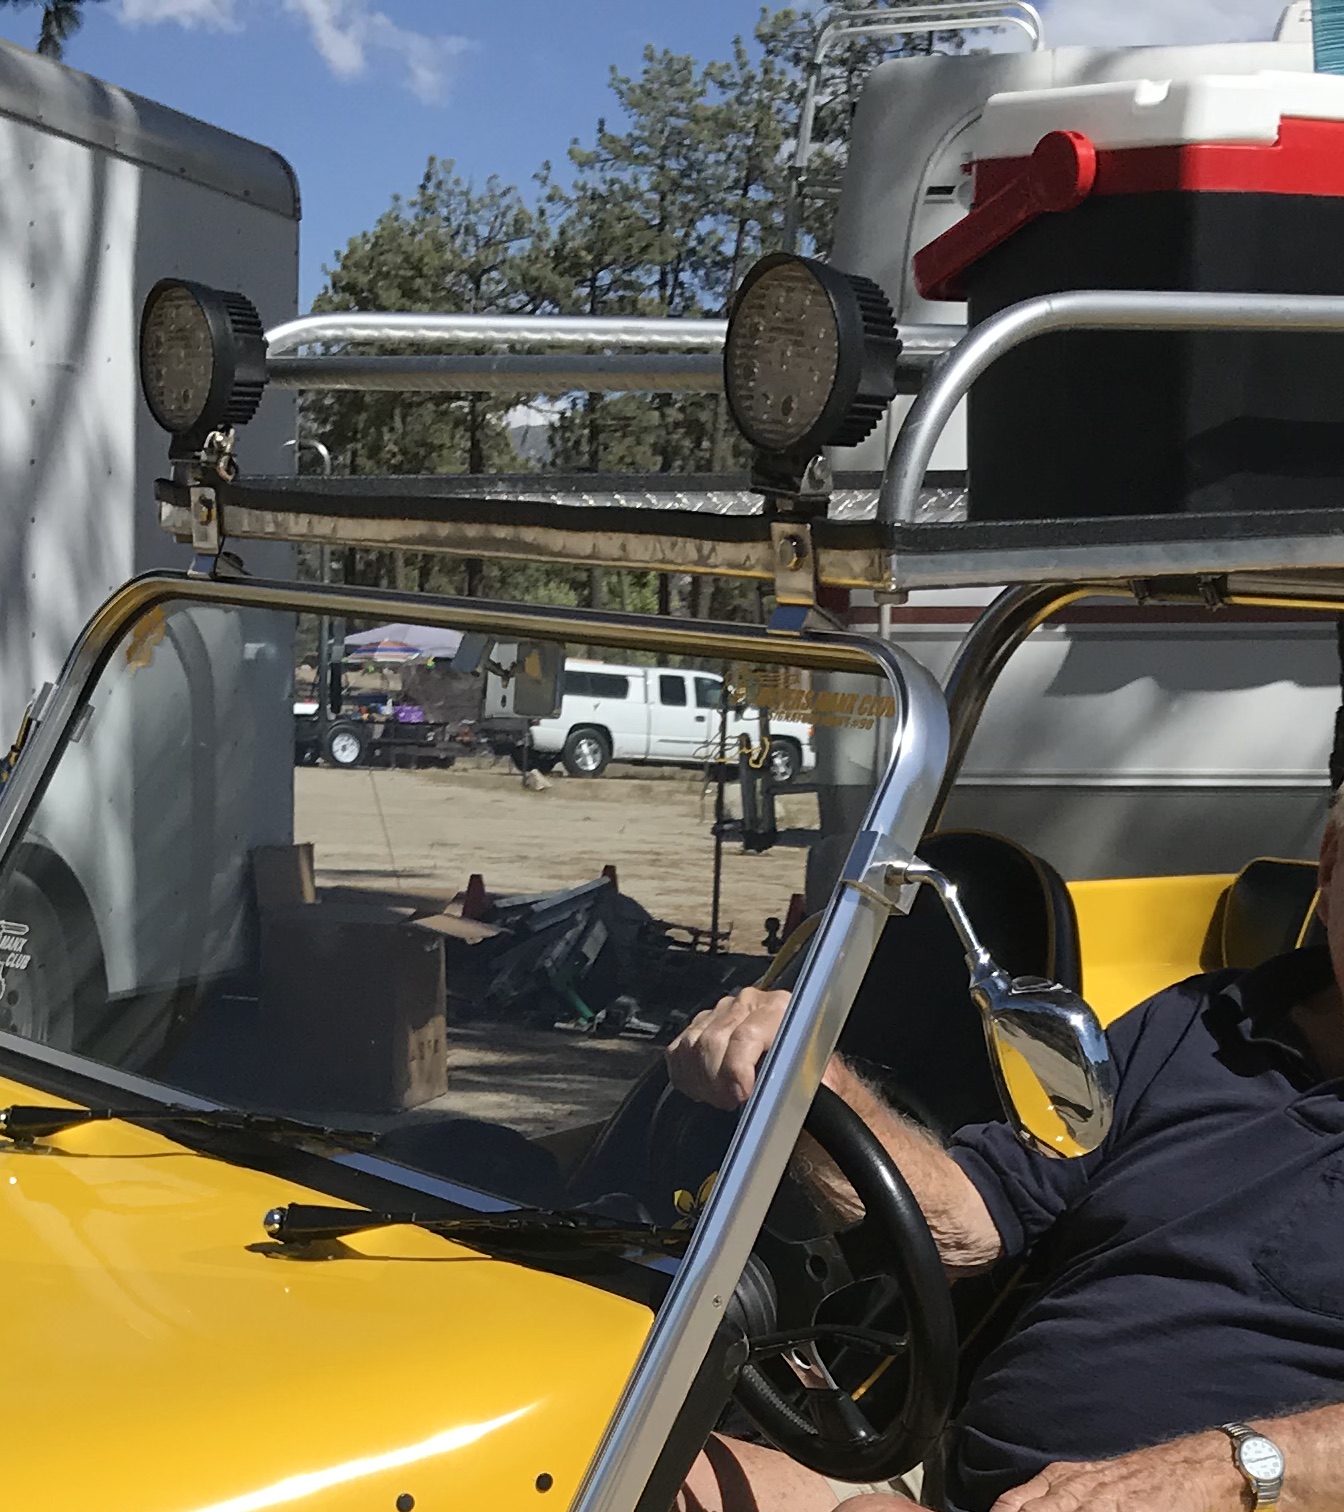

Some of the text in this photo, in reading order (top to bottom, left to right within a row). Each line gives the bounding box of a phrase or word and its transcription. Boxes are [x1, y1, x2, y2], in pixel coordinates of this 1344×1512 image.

[858, 695, 896, 718] CLUB
[0, 935, 28, 952] MANX
[5, 953, 31, 970] CLUB
